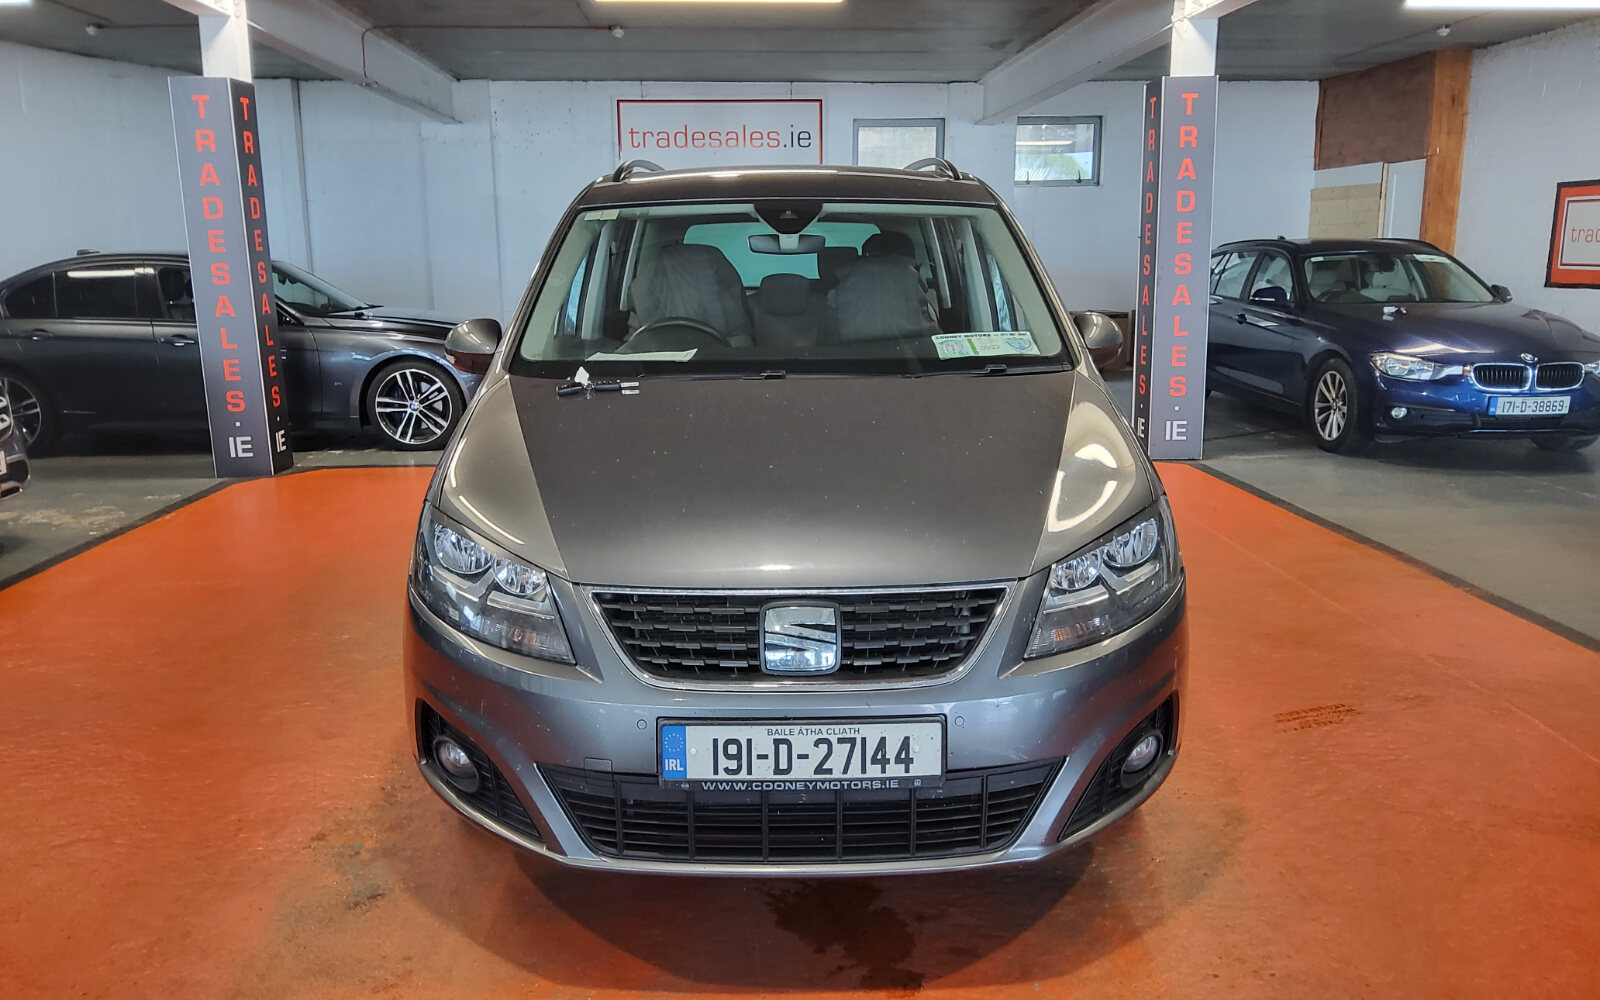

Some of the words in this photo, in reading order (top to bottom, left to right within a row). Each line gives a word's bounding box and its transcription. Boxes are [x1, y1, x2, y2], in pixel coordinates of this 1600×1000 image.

[628, 124, 812, 149] tradesales.ie
[1501, 400, 1564, 414] 171-D-38869
[767, 728, 795, 737] BAILE
[797, 726, 823, 737] ÁTHA
[826, 727, 860, 736] CLIATH
[712, 735, 914, 776] 191-D-27144
[664, 758, 684, 771] IRL
[702, 779, 899, 791] WWW.COONEYMOTORS.IE
